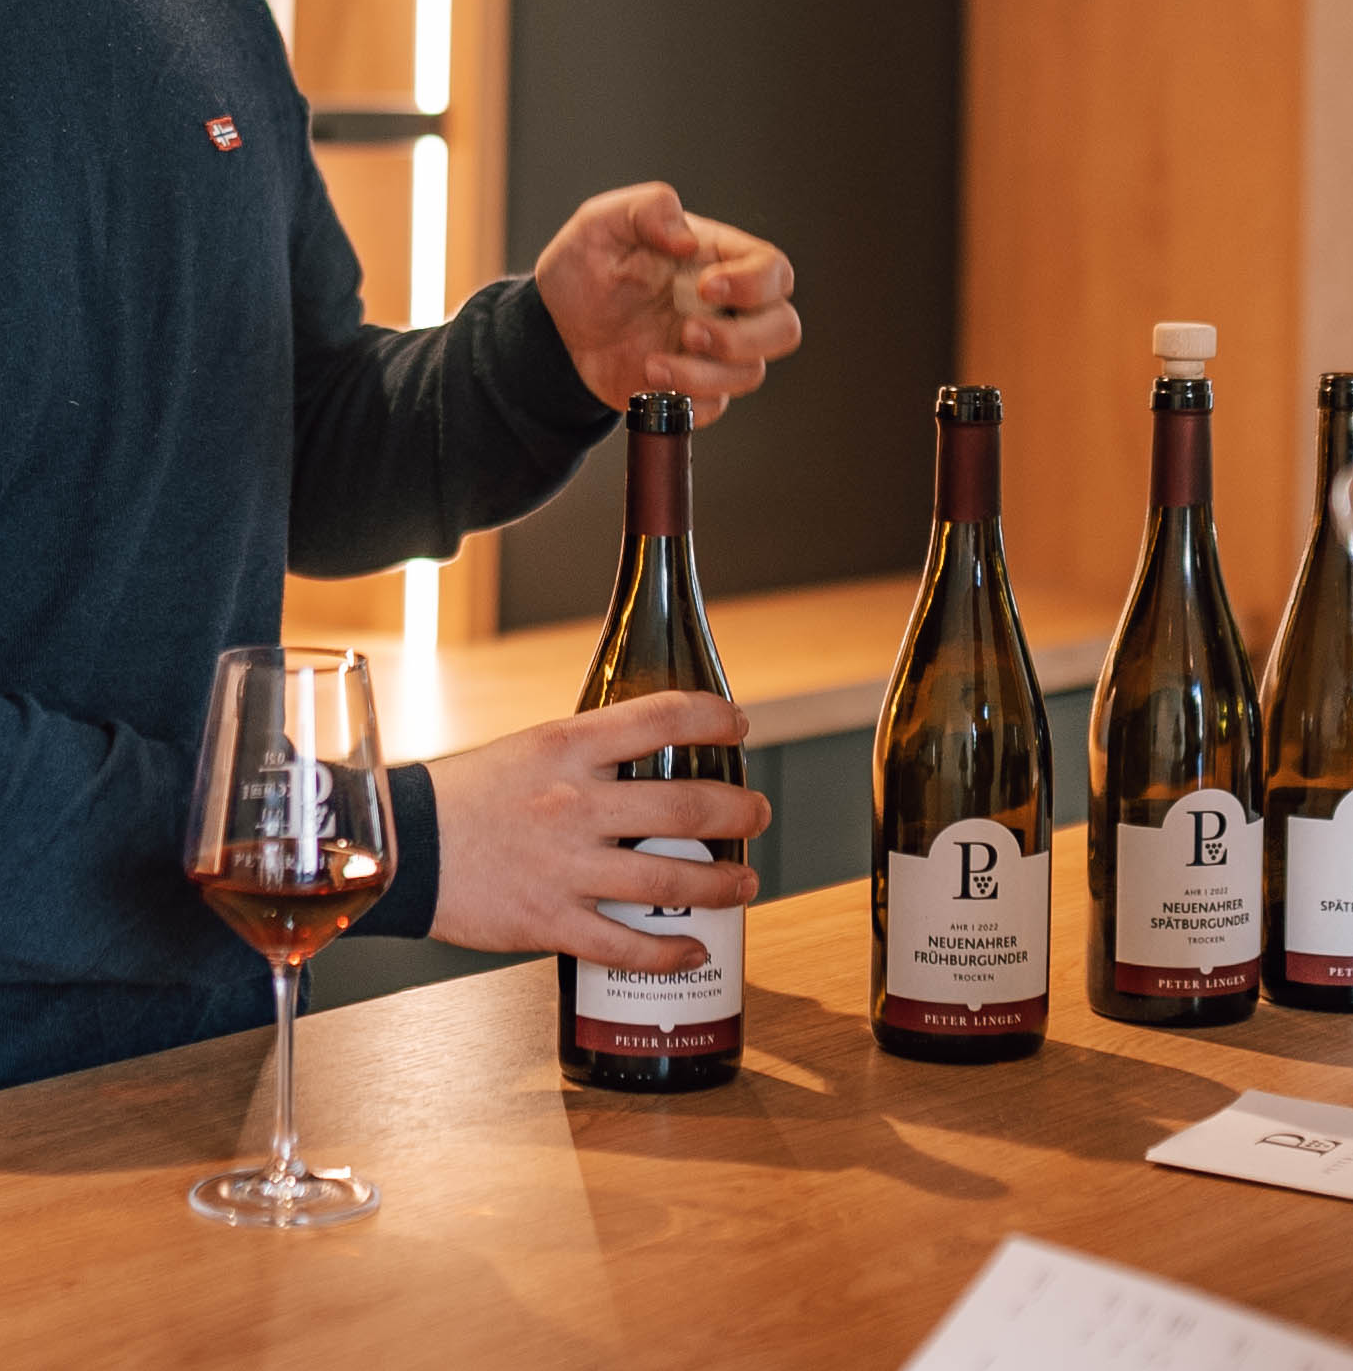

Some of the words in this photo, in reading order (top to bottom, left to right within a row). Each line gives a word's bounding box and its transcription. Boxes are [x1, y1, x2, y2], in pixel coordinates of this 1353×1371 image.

[1184, 888, 1201, 896] AHR
[1210, 887, 1228, 895] 2022
[1162, 898, 1243, 914] NEUENAHRER
[950, 923, 968, 931] AHR
[977, 923, 999, 931] 2022
[1150, 913, 1250, 930] SPÄTBURGUNDER
[928, 935, 1017, 949] NEUENAHRER
[1187, 936, 1225, 945] TROCKEN
[914, 950, 1028, 966] FRÜHBURGUNDER
[953, 973, 995, 982] TROCKEN
[1158, 979, 1200, 989] PETER
[1206, 975, 1246, 989] LINGEN
[607, 988, 684, 1001] SPÄTBURGUNDER
[687, 988, 722, 1000] TROCKEN
[924, 1013, 967, 1026] PETER
[974, 1013, 1021, 1026] LINGEN
[615, 1035, 659, 1049] PETER
[666, 1034, 715, 1048] LINGEN
